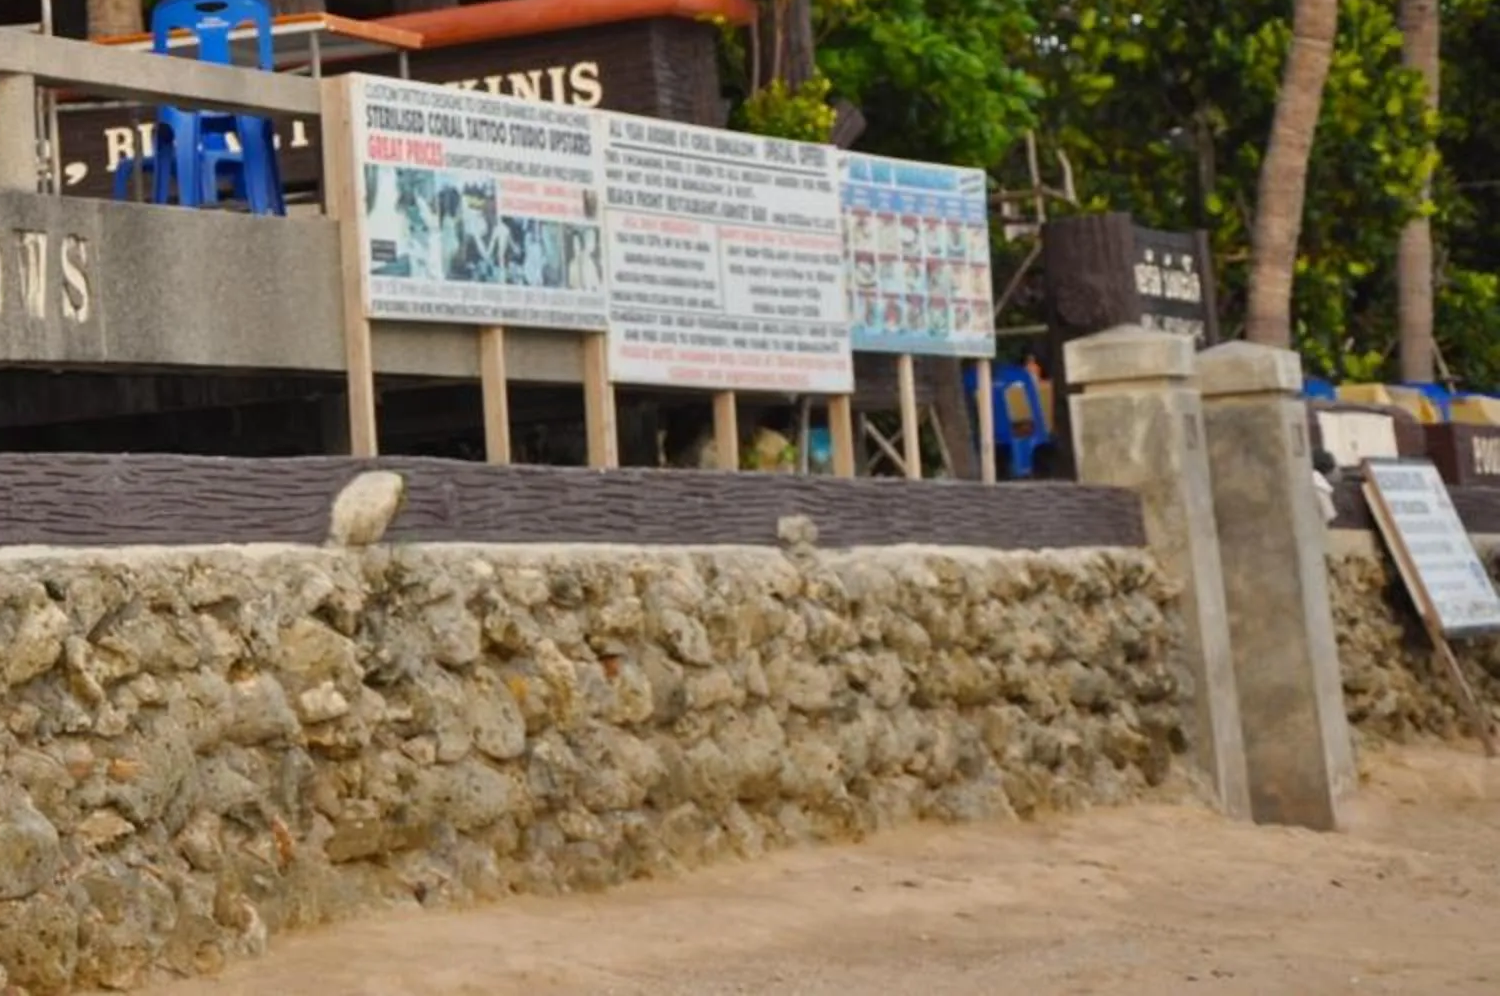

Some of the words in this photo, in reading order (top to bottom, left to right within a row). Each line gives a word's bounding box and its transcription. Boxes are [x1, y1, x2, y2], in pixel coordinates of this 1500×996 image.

[428, 111, 464, 140] CORAL
[466, 116, 507, 146] TATTOO
[368, 134, 403, 161] GREAT
